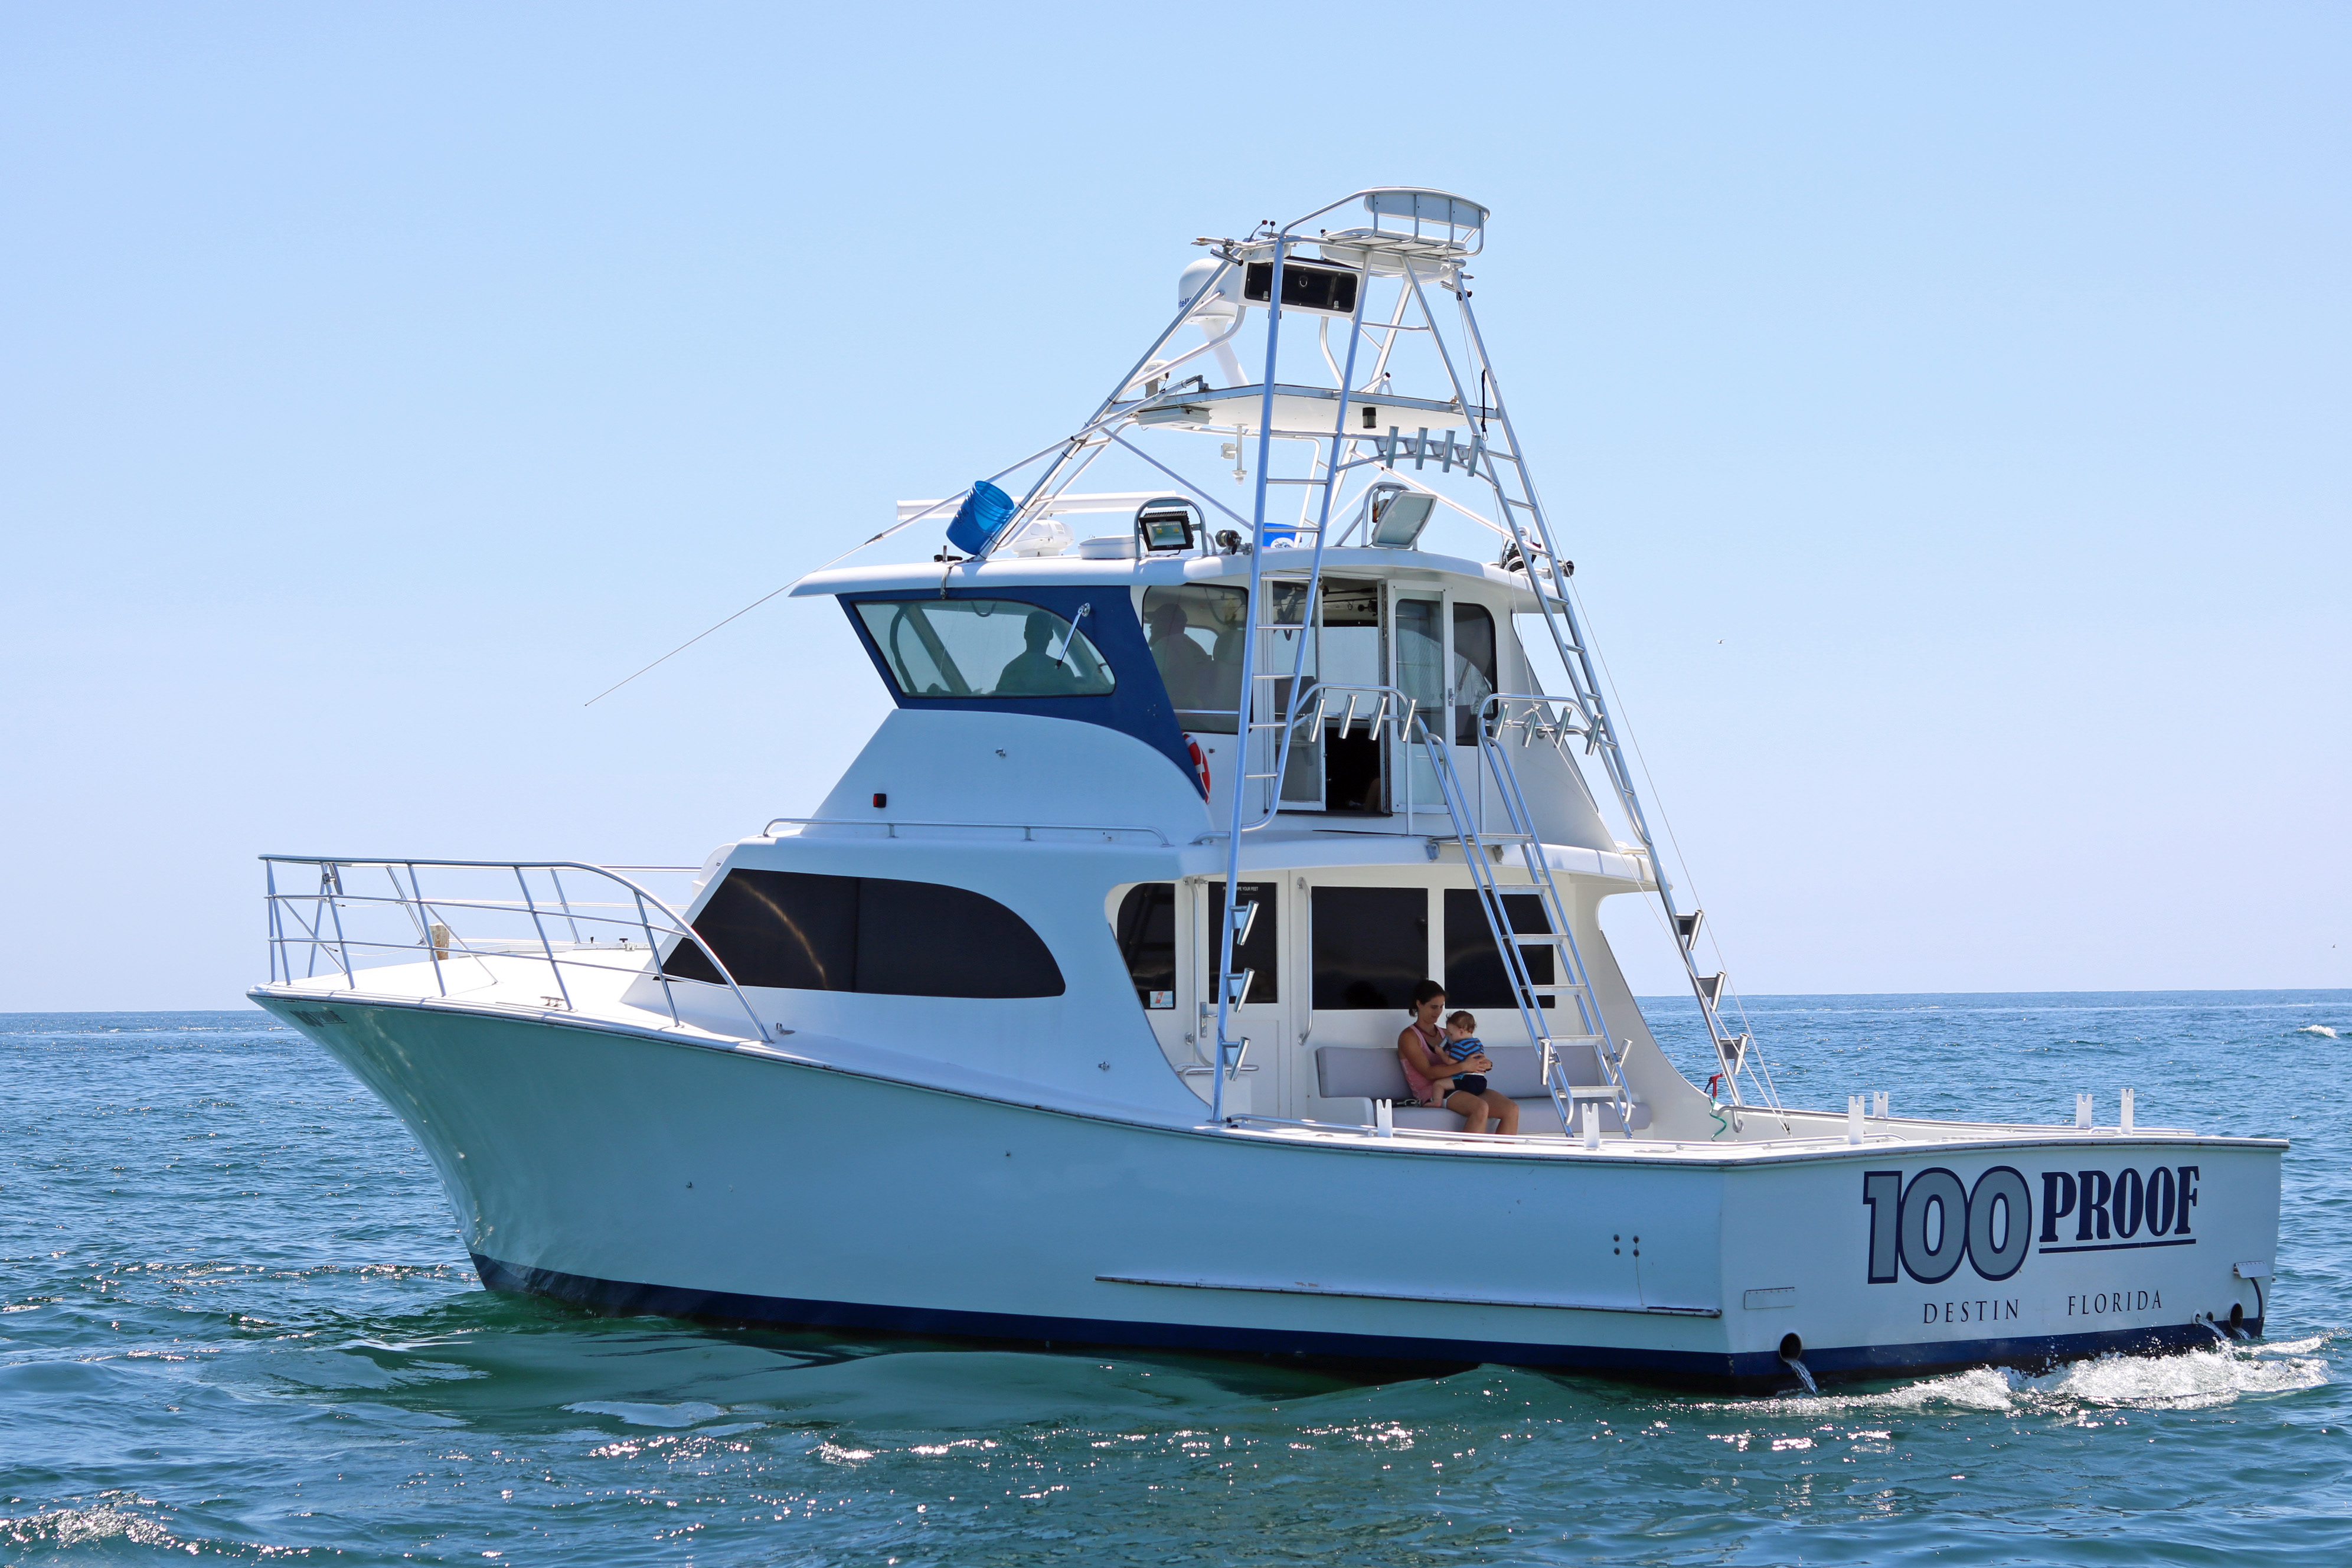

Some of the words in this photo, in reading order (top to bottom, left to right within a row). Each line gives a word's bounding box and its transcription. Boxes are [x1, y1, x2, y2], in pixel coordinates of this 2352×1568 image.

[1863, 1165, 2033, 1285] 100
[2039, 1165, 2200, 1243] PROOF
[1923, 1299, 2019, 1324] DESTIN
[2067, 1290, 2162, 1316] FLORIDA
